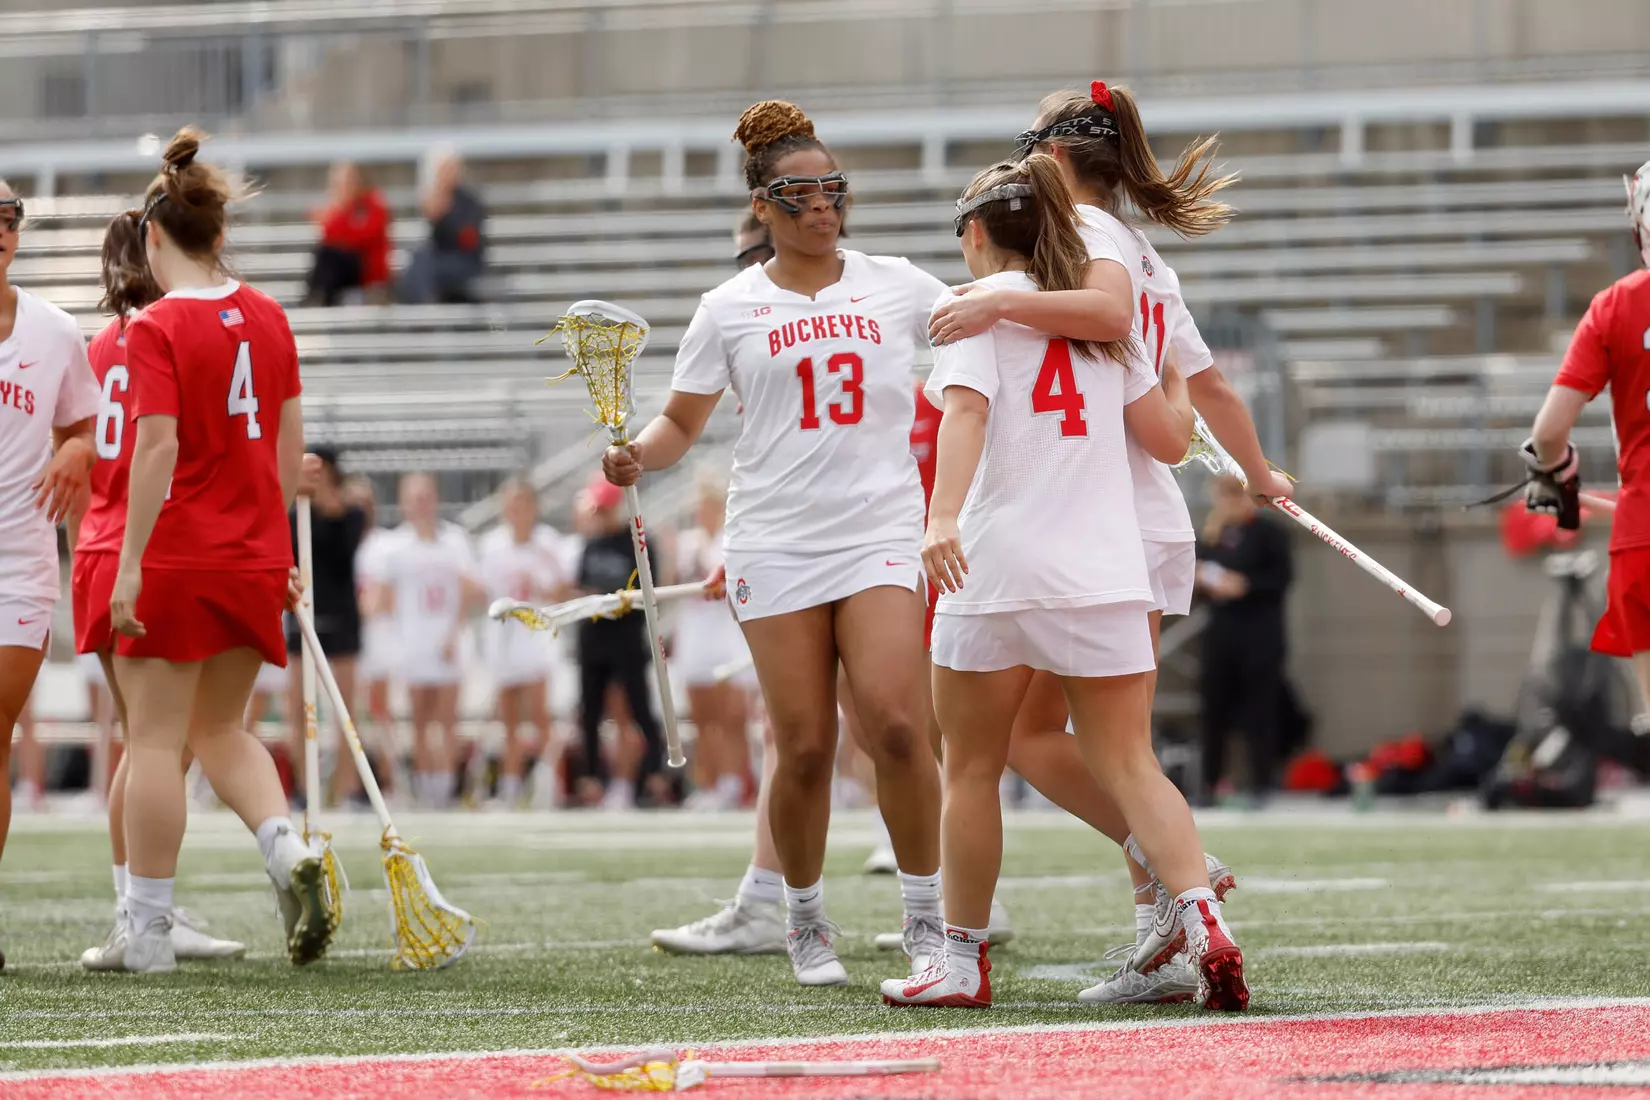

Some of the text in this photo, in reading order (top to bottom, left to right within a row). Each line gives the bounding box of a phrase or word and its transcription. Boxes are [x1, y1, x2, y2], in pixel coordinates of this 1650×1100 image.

[768, 314, 881, 358] BUCKEYES
[1140, 291, 1165, 375] 11
[226, 340, 262, 440] 4
[796, 352, 864, 430] 13
[1031, 338, 1088, 438] 4
